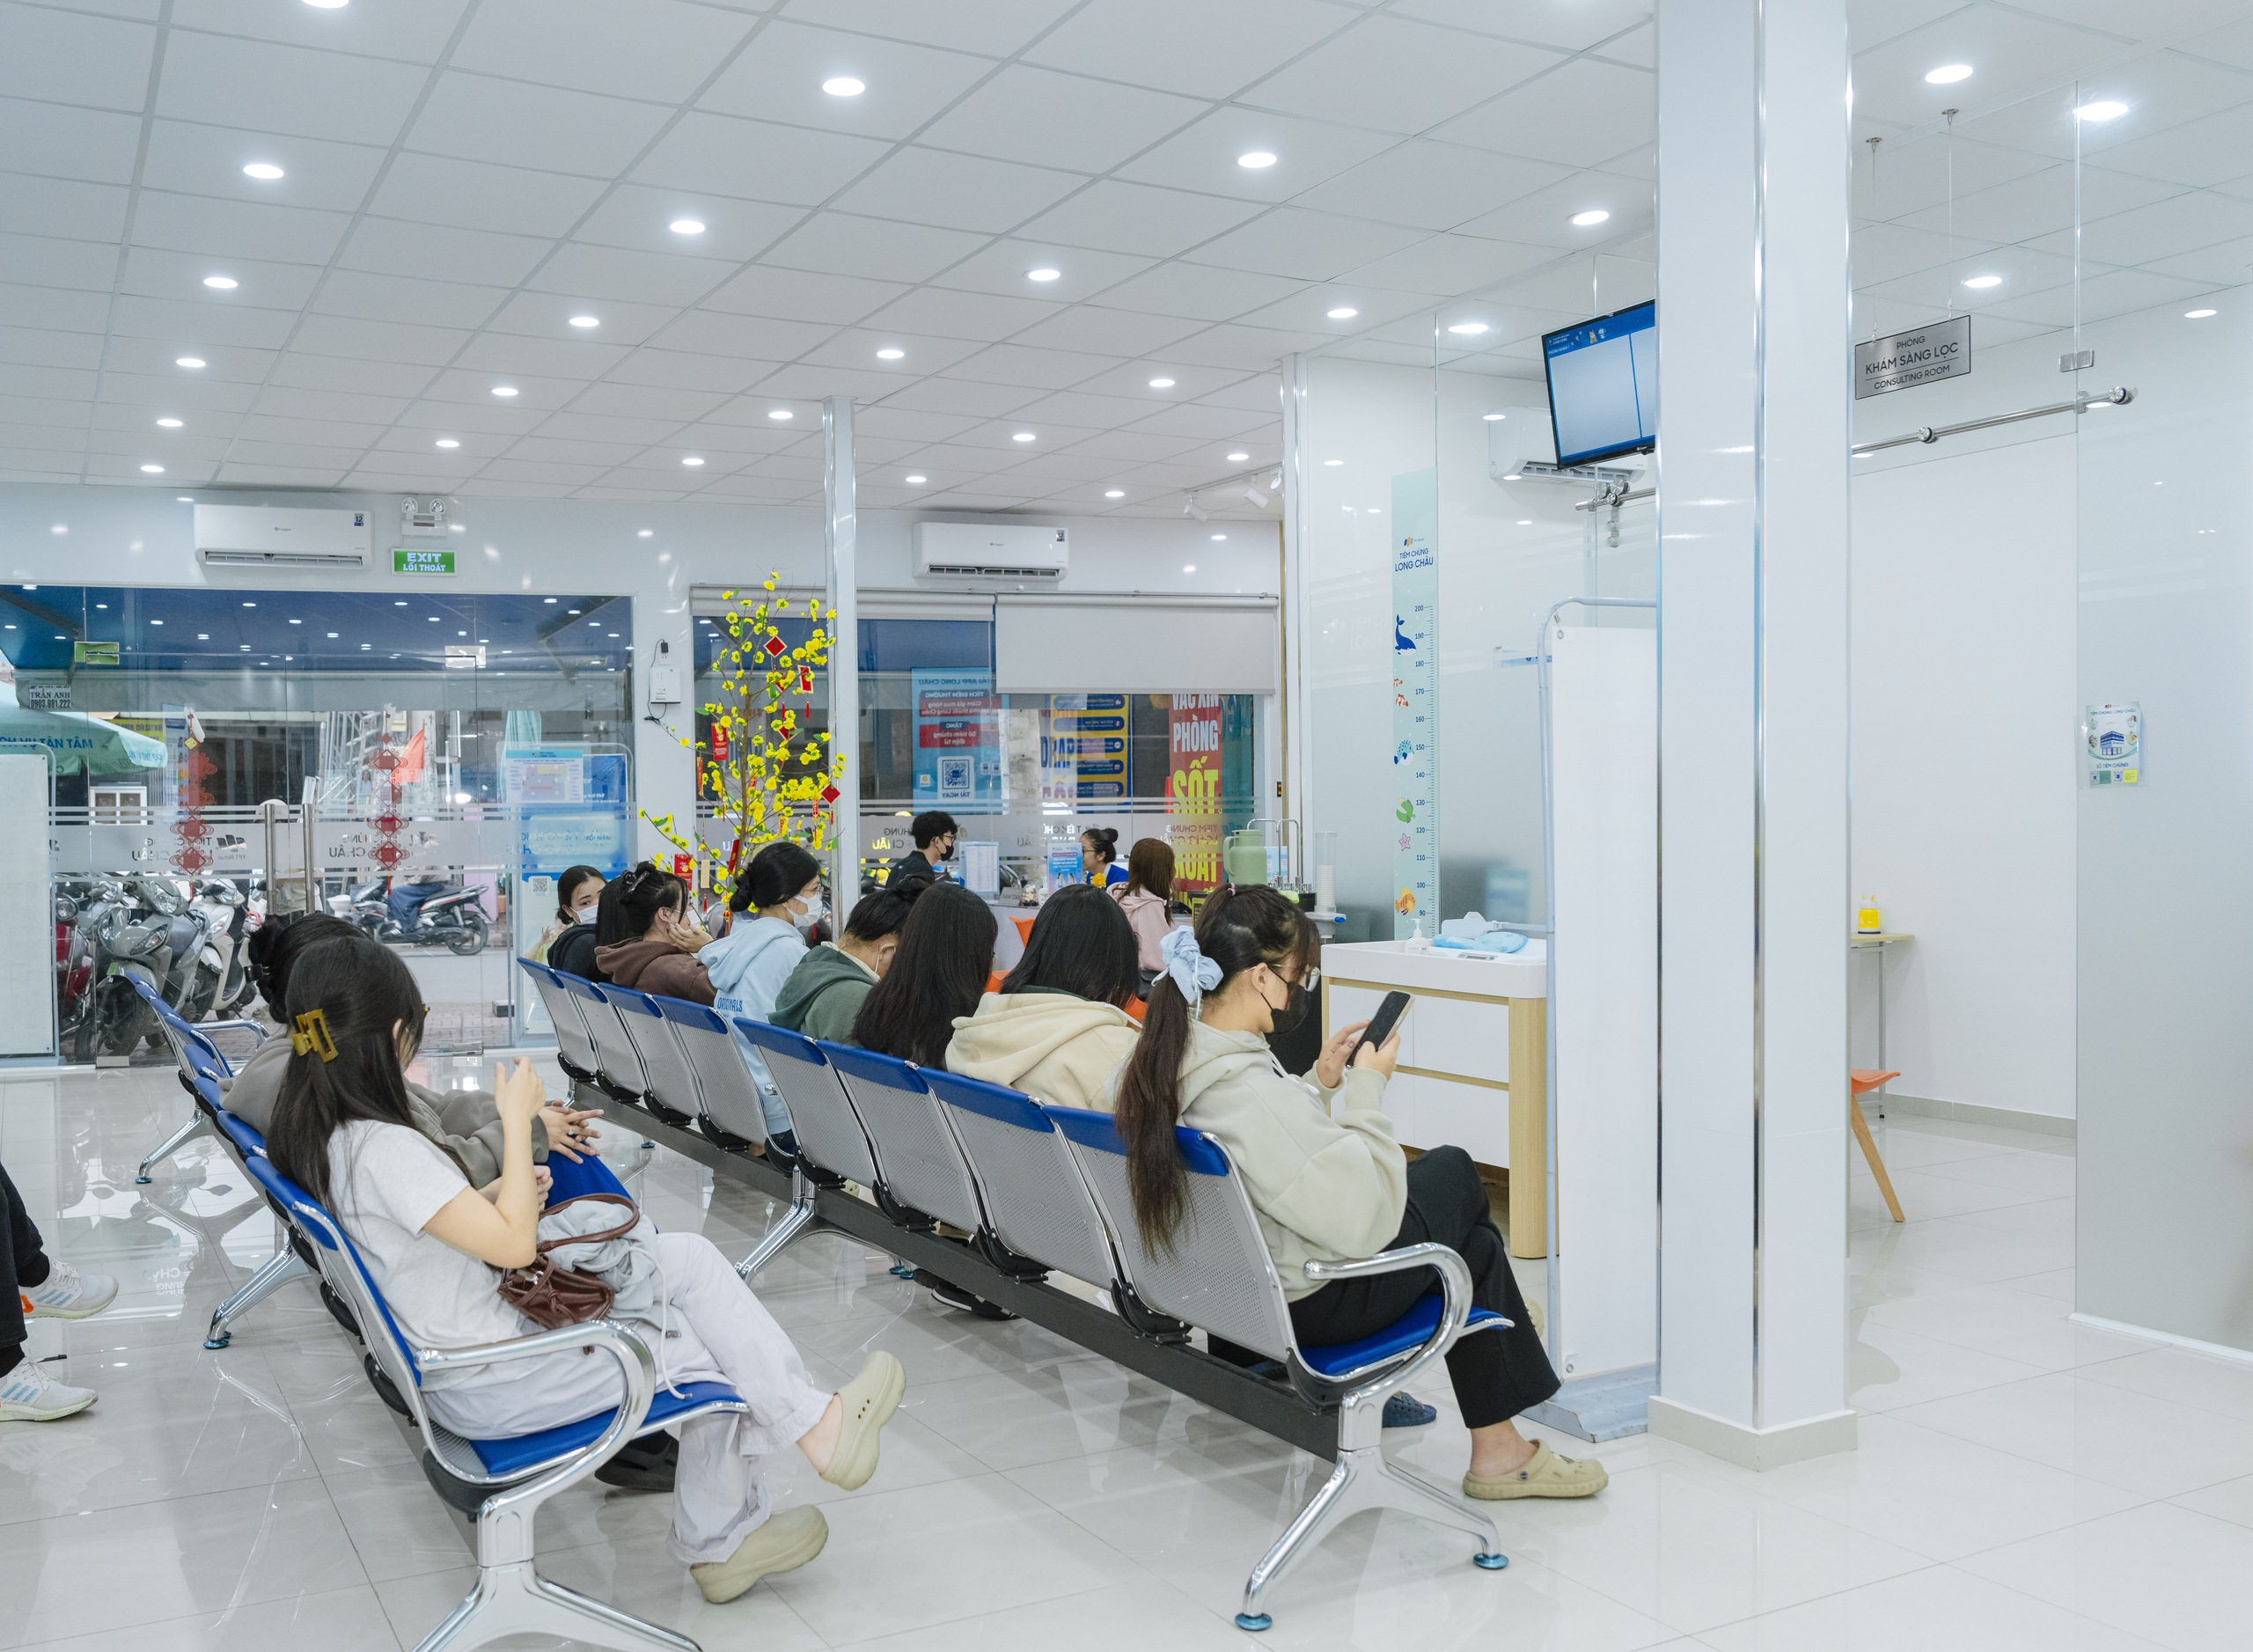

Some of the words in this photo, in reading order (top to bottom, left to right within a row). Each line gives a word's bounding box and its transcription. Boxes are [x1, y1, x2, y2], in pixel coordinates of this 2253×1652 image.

[1897, 335, 1926, 349] PHÒNG
[1866, 357, 1897, 374] KHÁM
[1899, 349, 1932, 366] SÀNG
[1934, 341, 1958, 359] LỌC
[1874, 371, 1923, 389] CONSULTING
[1925, 364, 1950, 378] ROOM
[407, 552, 442, 562] EXIT
[1395, 560, 1413, 572] LONG
[1414, 554, 1434, 569] CHÂU
[419, 563, 446, 572] THOÁT
[31, 688, 51, 698] TRẦN
[1172, 714, 1219, 753] PHÒNG
[1172, 755, 1219, 813] SỐT
